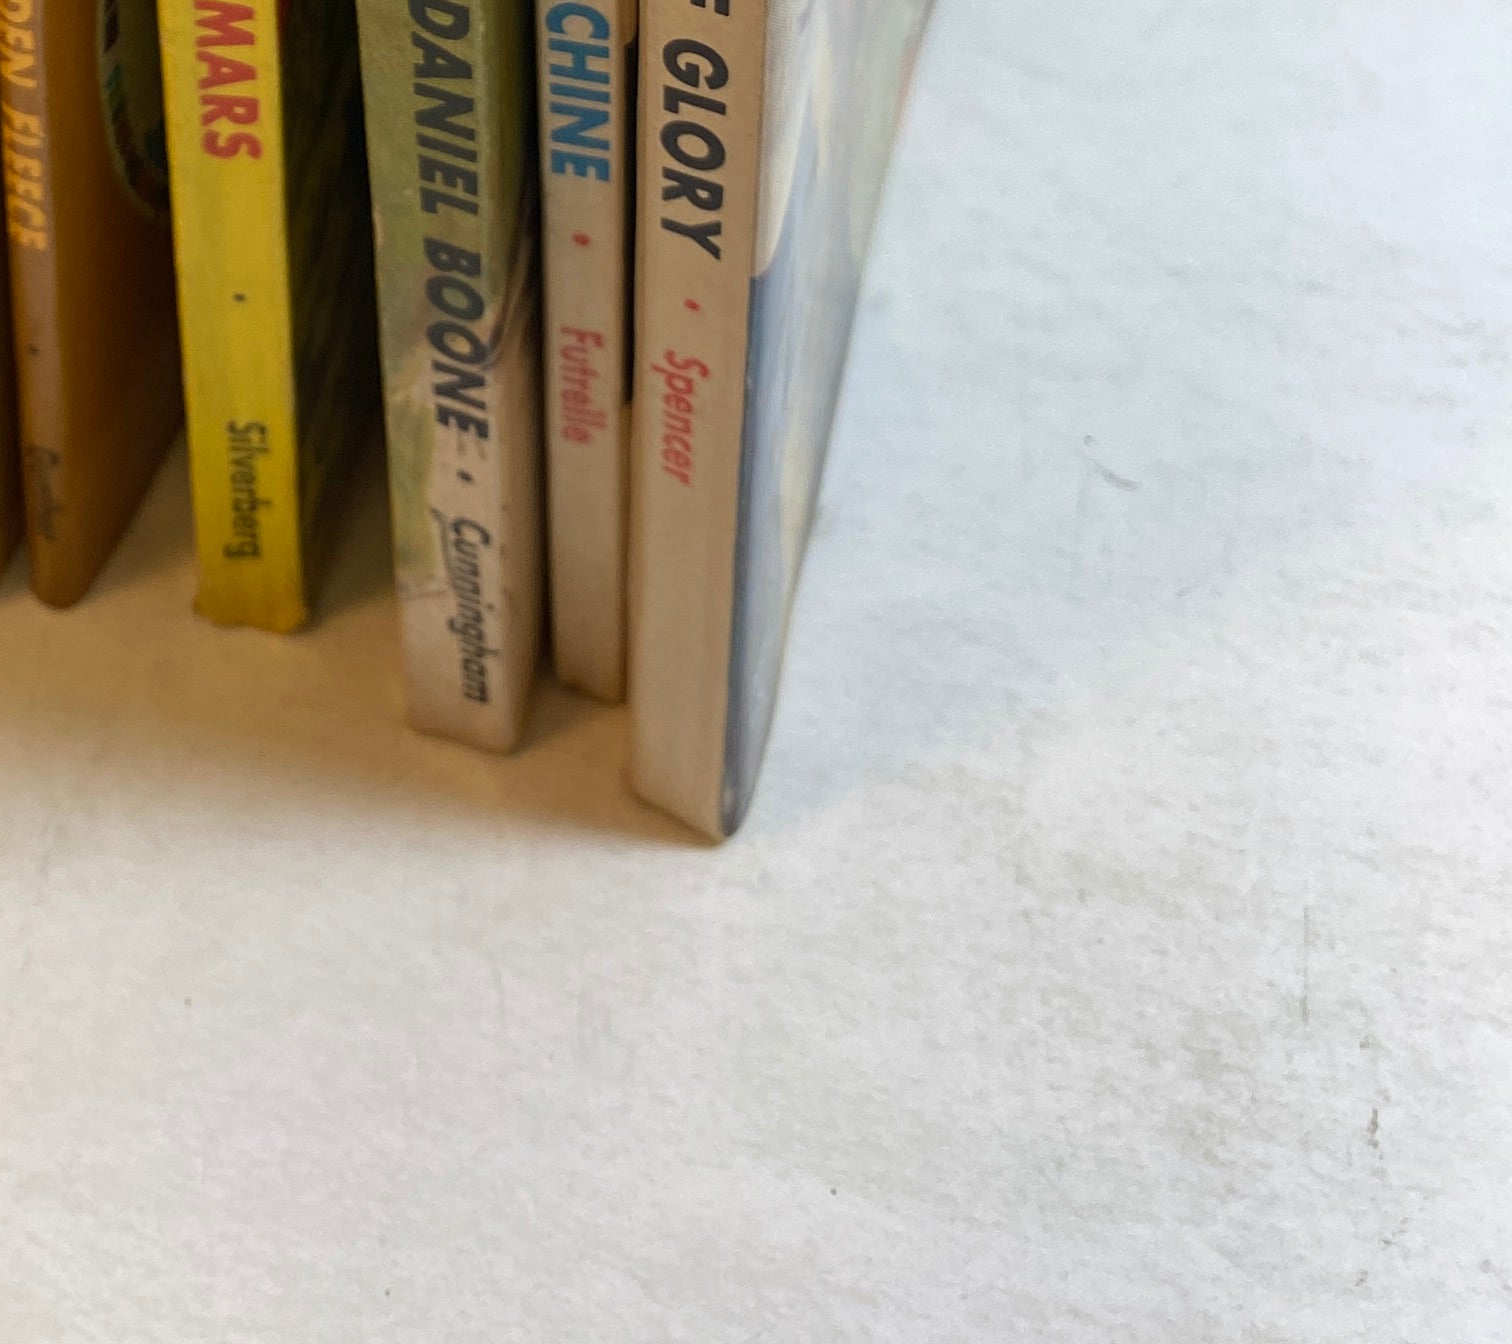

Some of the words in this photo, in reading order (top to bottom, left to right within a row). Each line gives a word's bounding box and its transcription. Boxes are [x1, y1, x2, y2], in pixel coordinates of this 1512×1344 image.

[0, 104, 51, 252] FLEECE
[658, 38, 729, 261] GLORY
[422, 241, 490, 443] BOONE
[560, 325, 608, 444] Futrelle
[224, 419, 266, 562] Silverberg
[655, 349, 708, 485] Spencer
[444, 516, 495, 707] Cunningham
